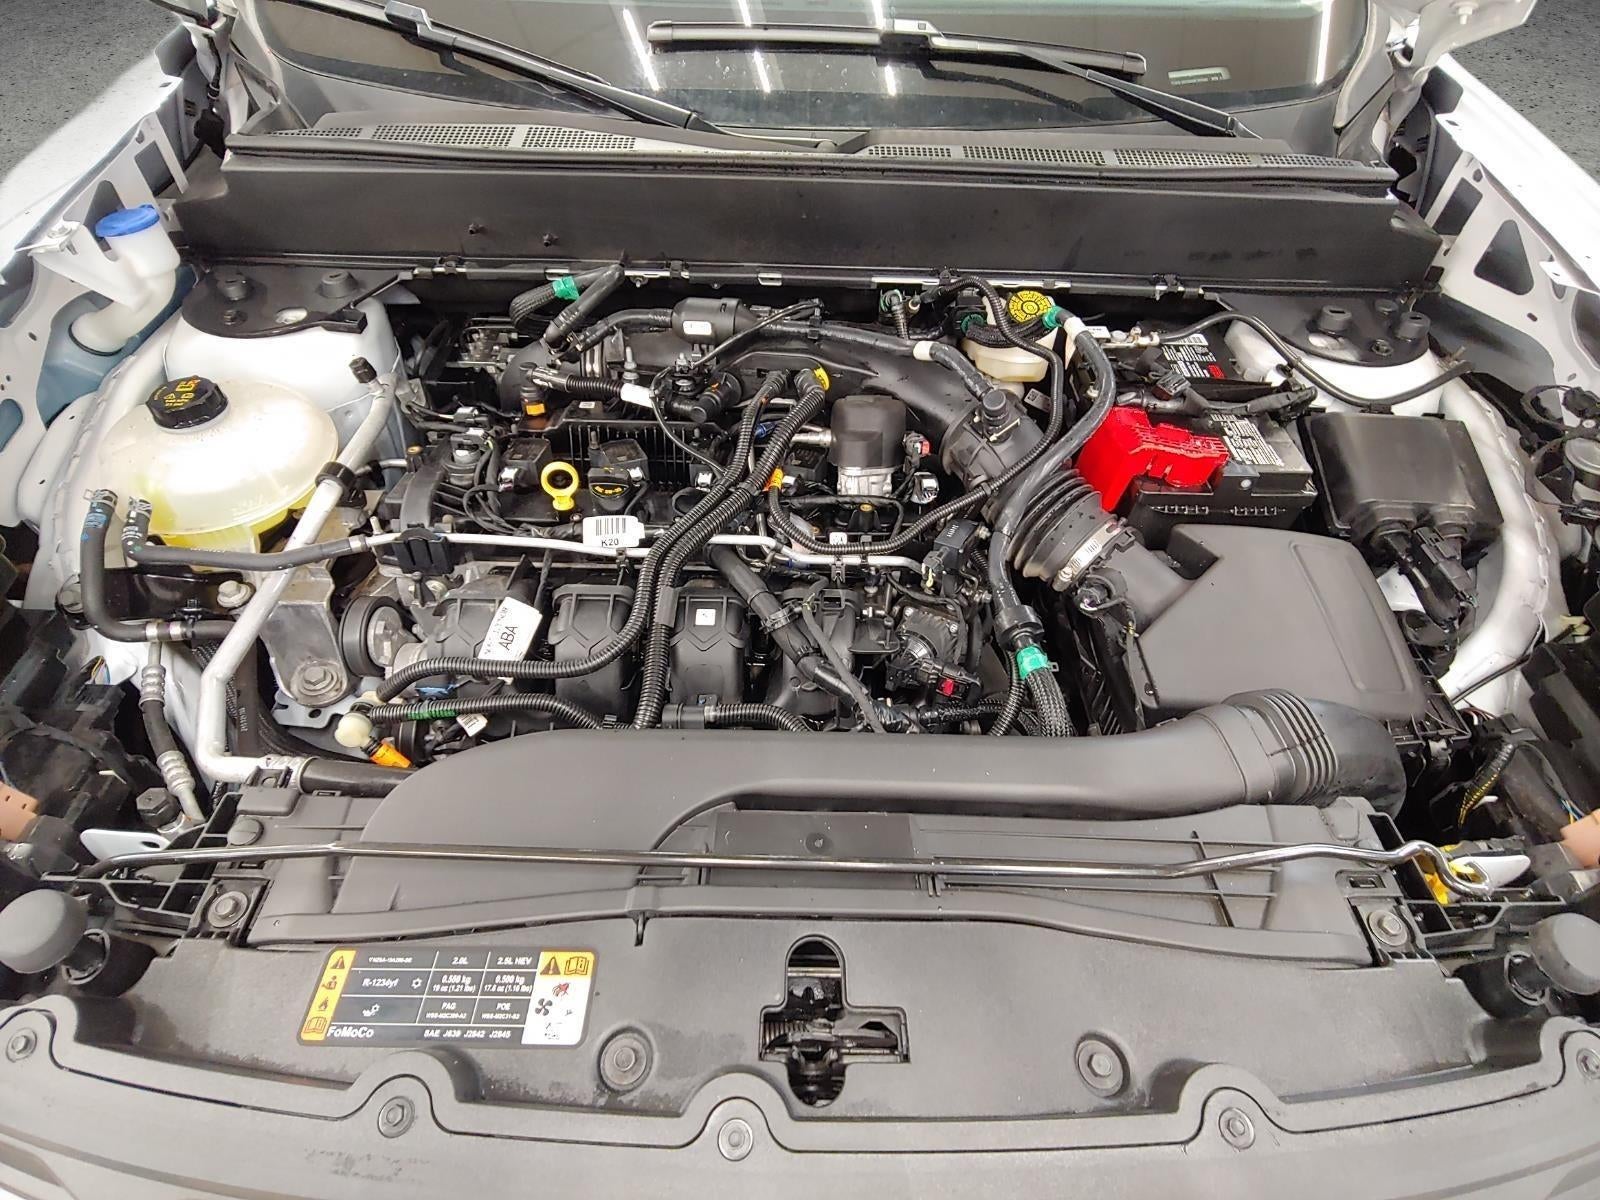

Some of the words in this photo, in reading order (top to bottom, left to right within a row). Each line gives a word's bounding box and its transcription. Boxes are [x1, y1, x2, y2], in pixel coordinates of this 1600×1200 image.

[601, 538, 619, 547] K20
[498, 626, 518, 651] ABA
[451, 956, 469, 965] 2.0L
[496, 956, 513, 965] 2.5L
[514, 956, 532, 965] HEV
[362, 978, 399, 989] R-1234yf
[462, 975, 472, 985] kg
[515, 975, 525, 986] kg
[441, 1002, 457, 1010] PAG
[496, 1002, 511, 1010] POE
[327, 1026, 374, 1037] FoMoCo
[423, 1029, 440, 1038] SAE
